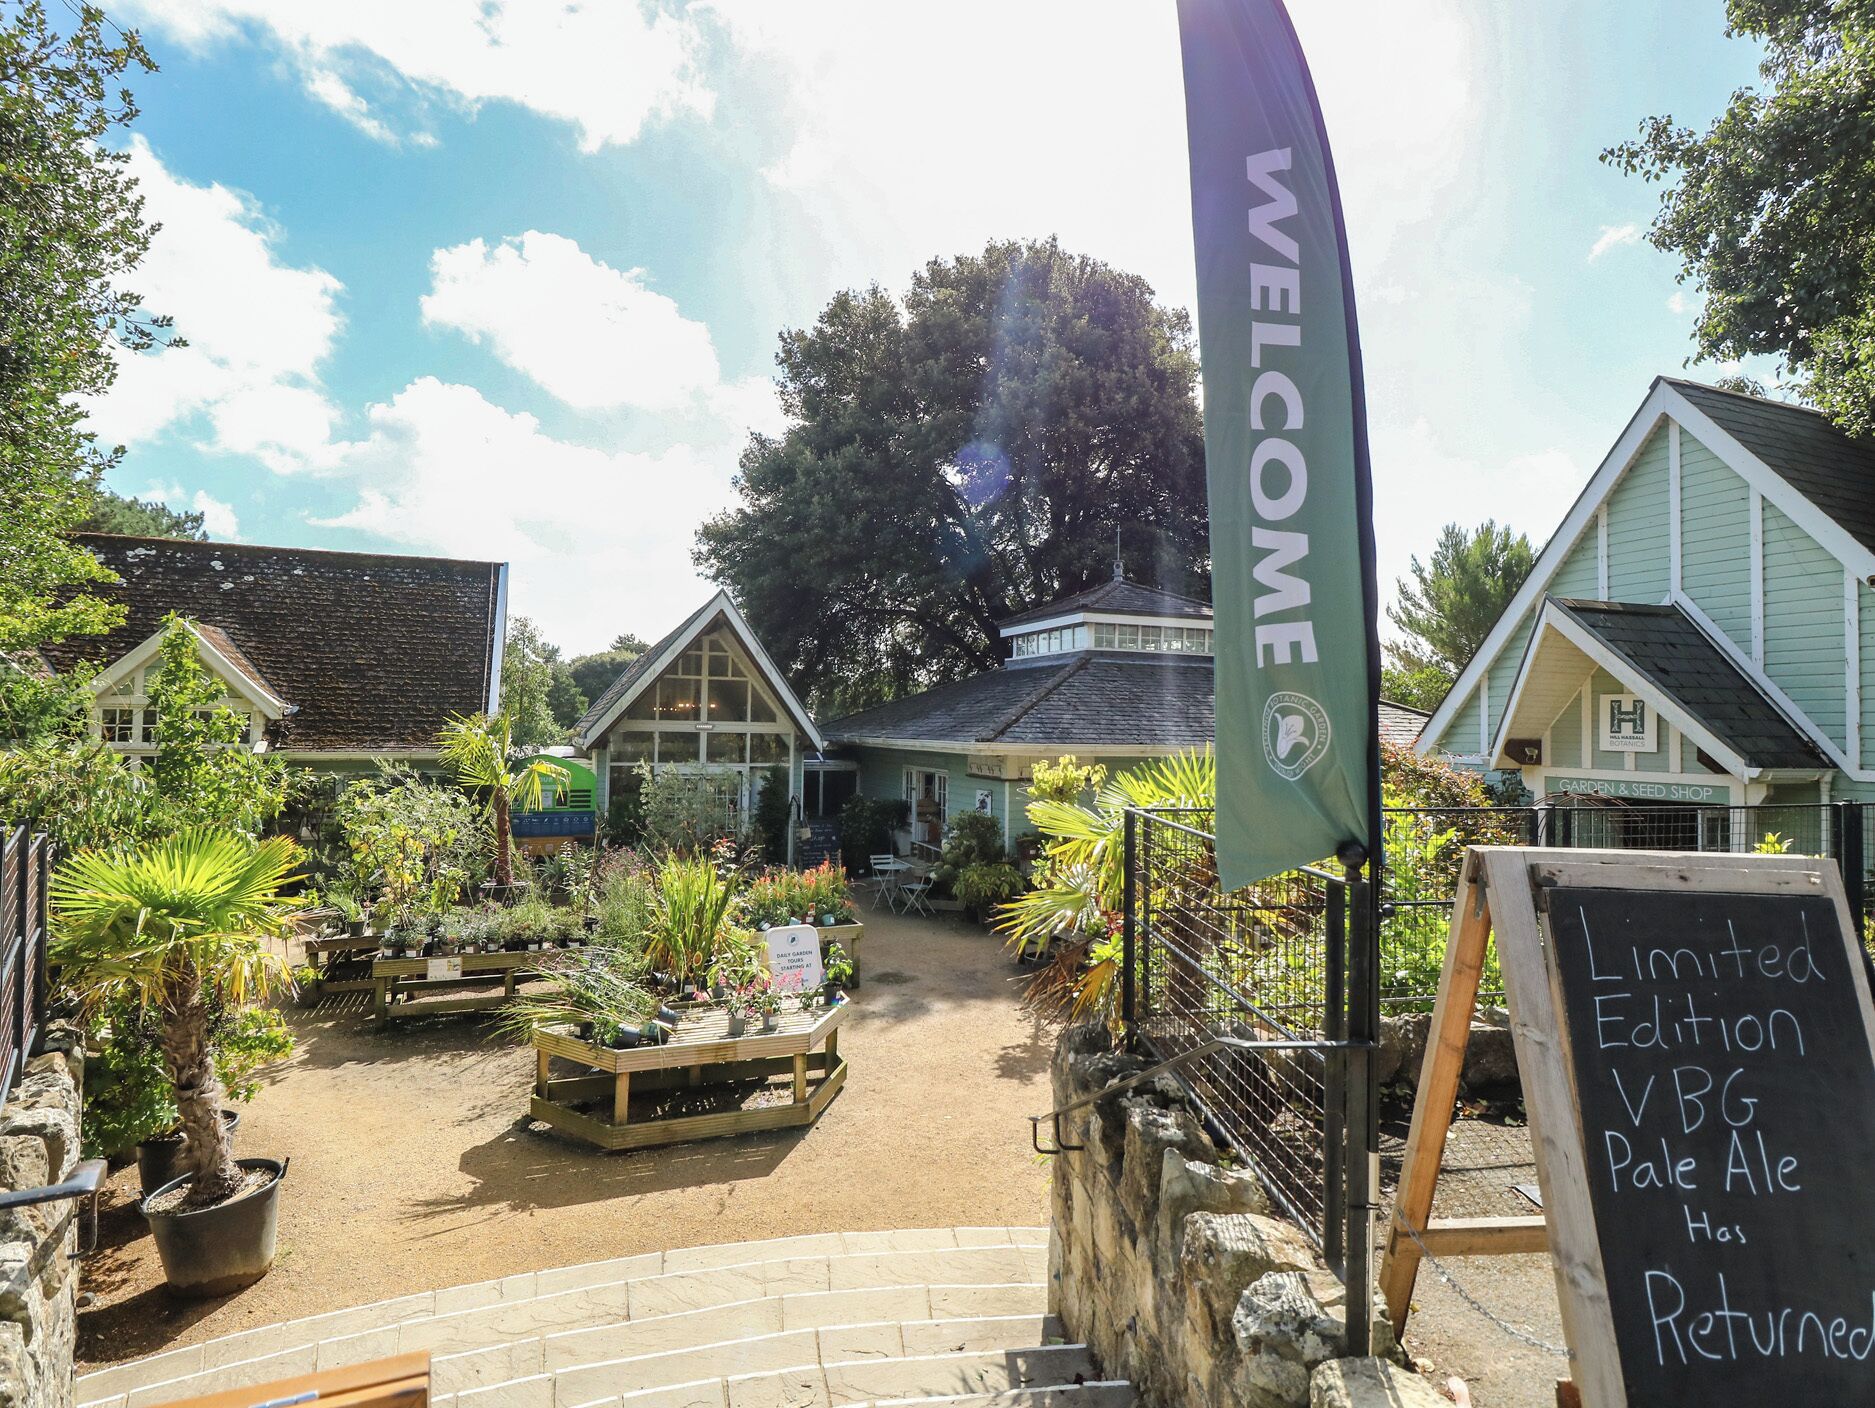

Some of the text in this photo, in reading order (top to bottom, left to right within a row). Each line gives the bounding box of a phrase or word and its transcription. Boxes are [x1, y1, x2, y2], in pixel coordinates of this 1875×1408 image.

[1245, 147, 1318, 668] WELCOME
[1310, 706, 1327, 742] GARDEN
[1610, 699, 1645, 734] H
[1559, 779, 1713, 800] GARDEN & SEED SHOP
[1580, 906, 1826, 983] Limited
[1594, 993, 1804, 1056] Edition
[1605, 1130, 1801, 1195] Pale Ale
[1684, 1205, 1746, 1244] Has
[1644, 1270, 1875, 1367] Returned
